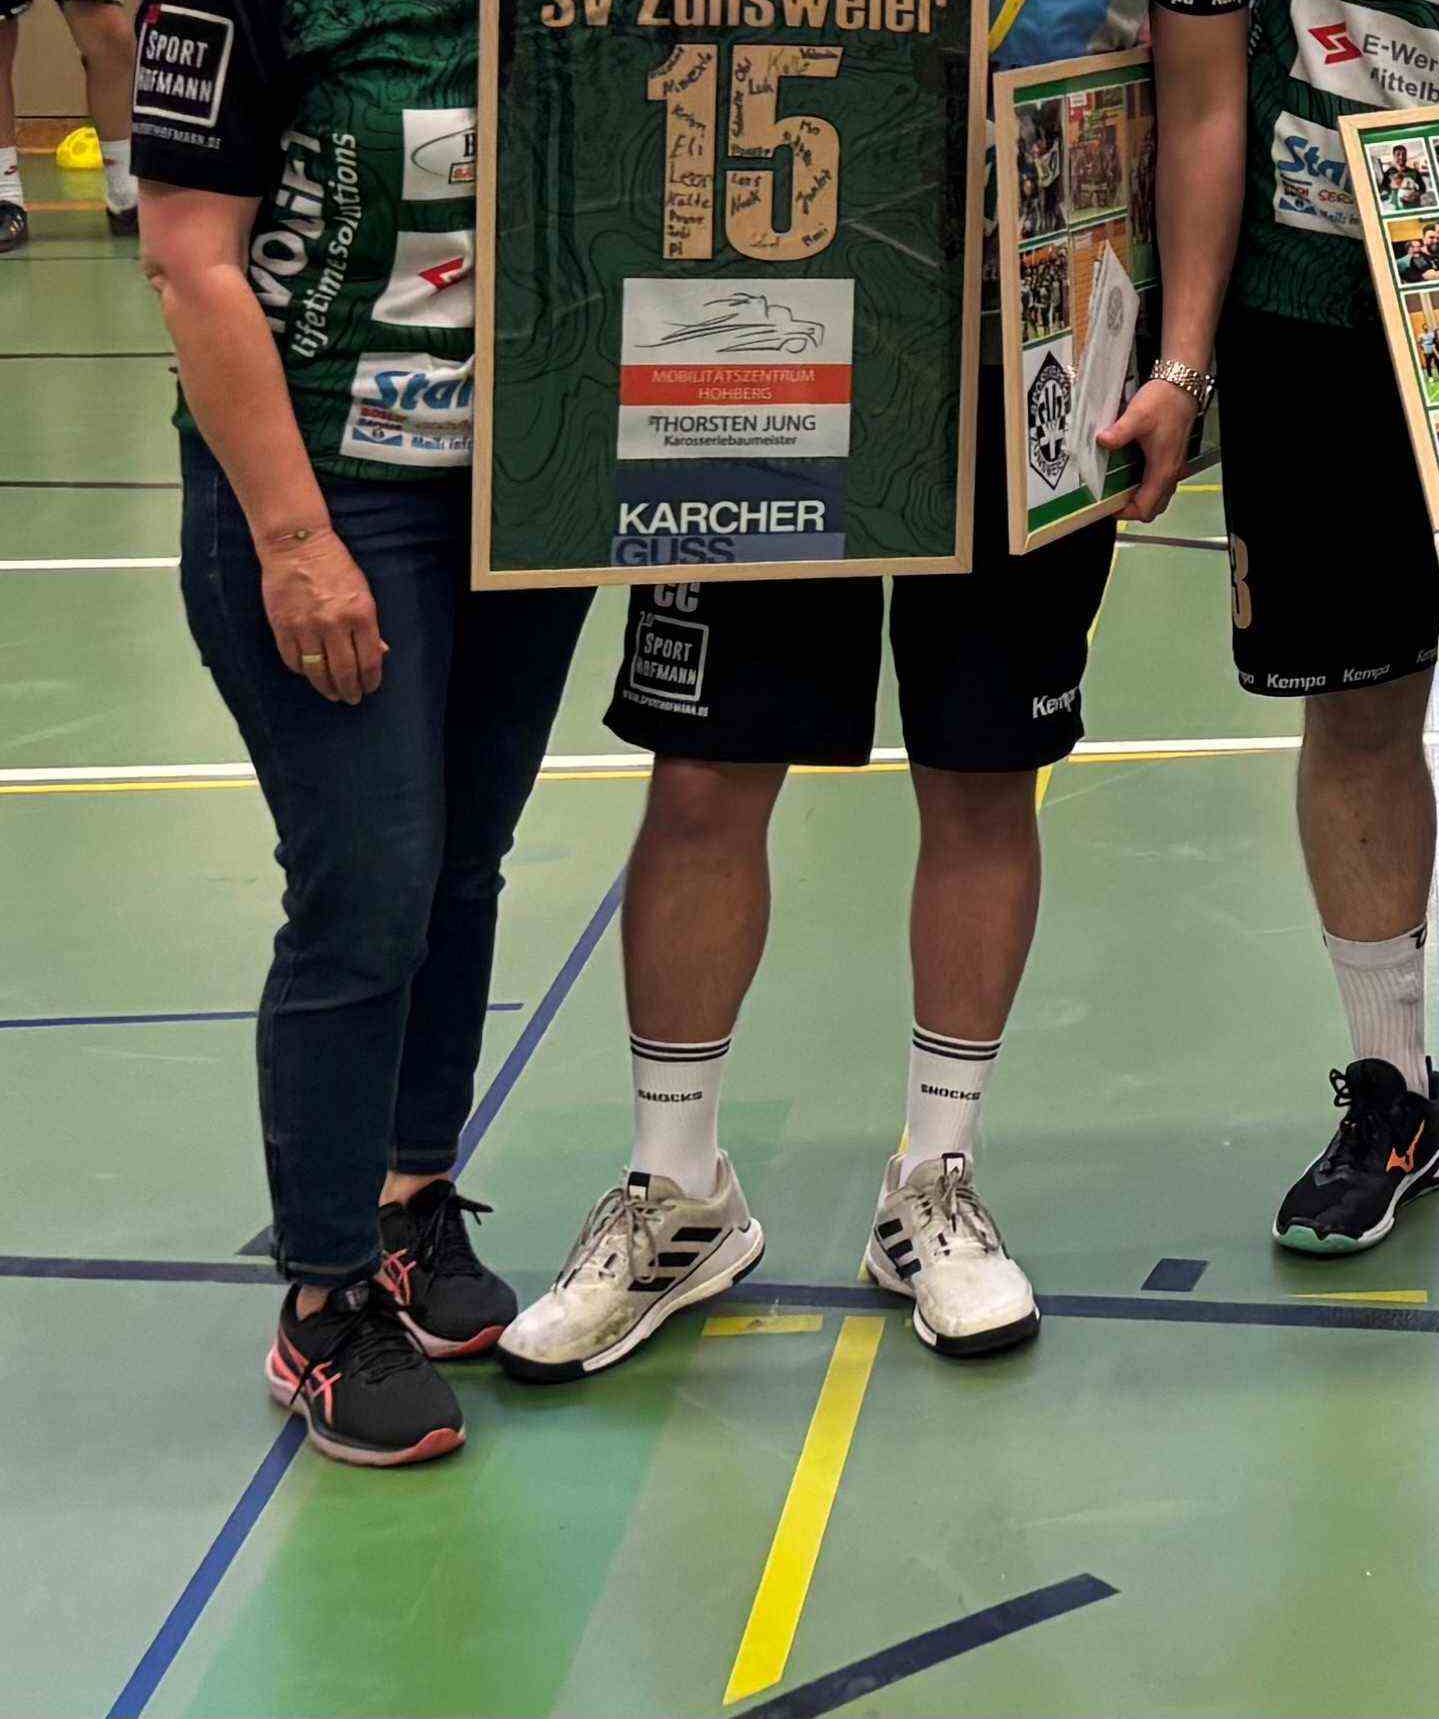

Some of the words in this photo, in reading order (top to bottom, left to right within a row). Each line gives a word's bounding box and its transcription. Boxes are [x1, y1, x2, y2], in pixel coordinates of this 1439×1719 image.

[147, 30, 208, 68] SPORT
[647, 44, 843, 262] 15
[1278, 135, 1347, 186] Sta
[698, 386, 774, 401] HOHBERG
[652, 415, 757, 433] THORSTEN
[758, 414, 816, 432] JUNG
[664, 434, 798, 448] Karosseriebaumeister
[618, 500, 826, 534] KARCHER
[615, 535, 736, 567] GUSS
[654, 581, 700, 614] CC
[644, 632, 693, 662] SPORT
[1266, 671, 1327, 693] Kempa
[1343, 663, 1391, 683] Kempa
